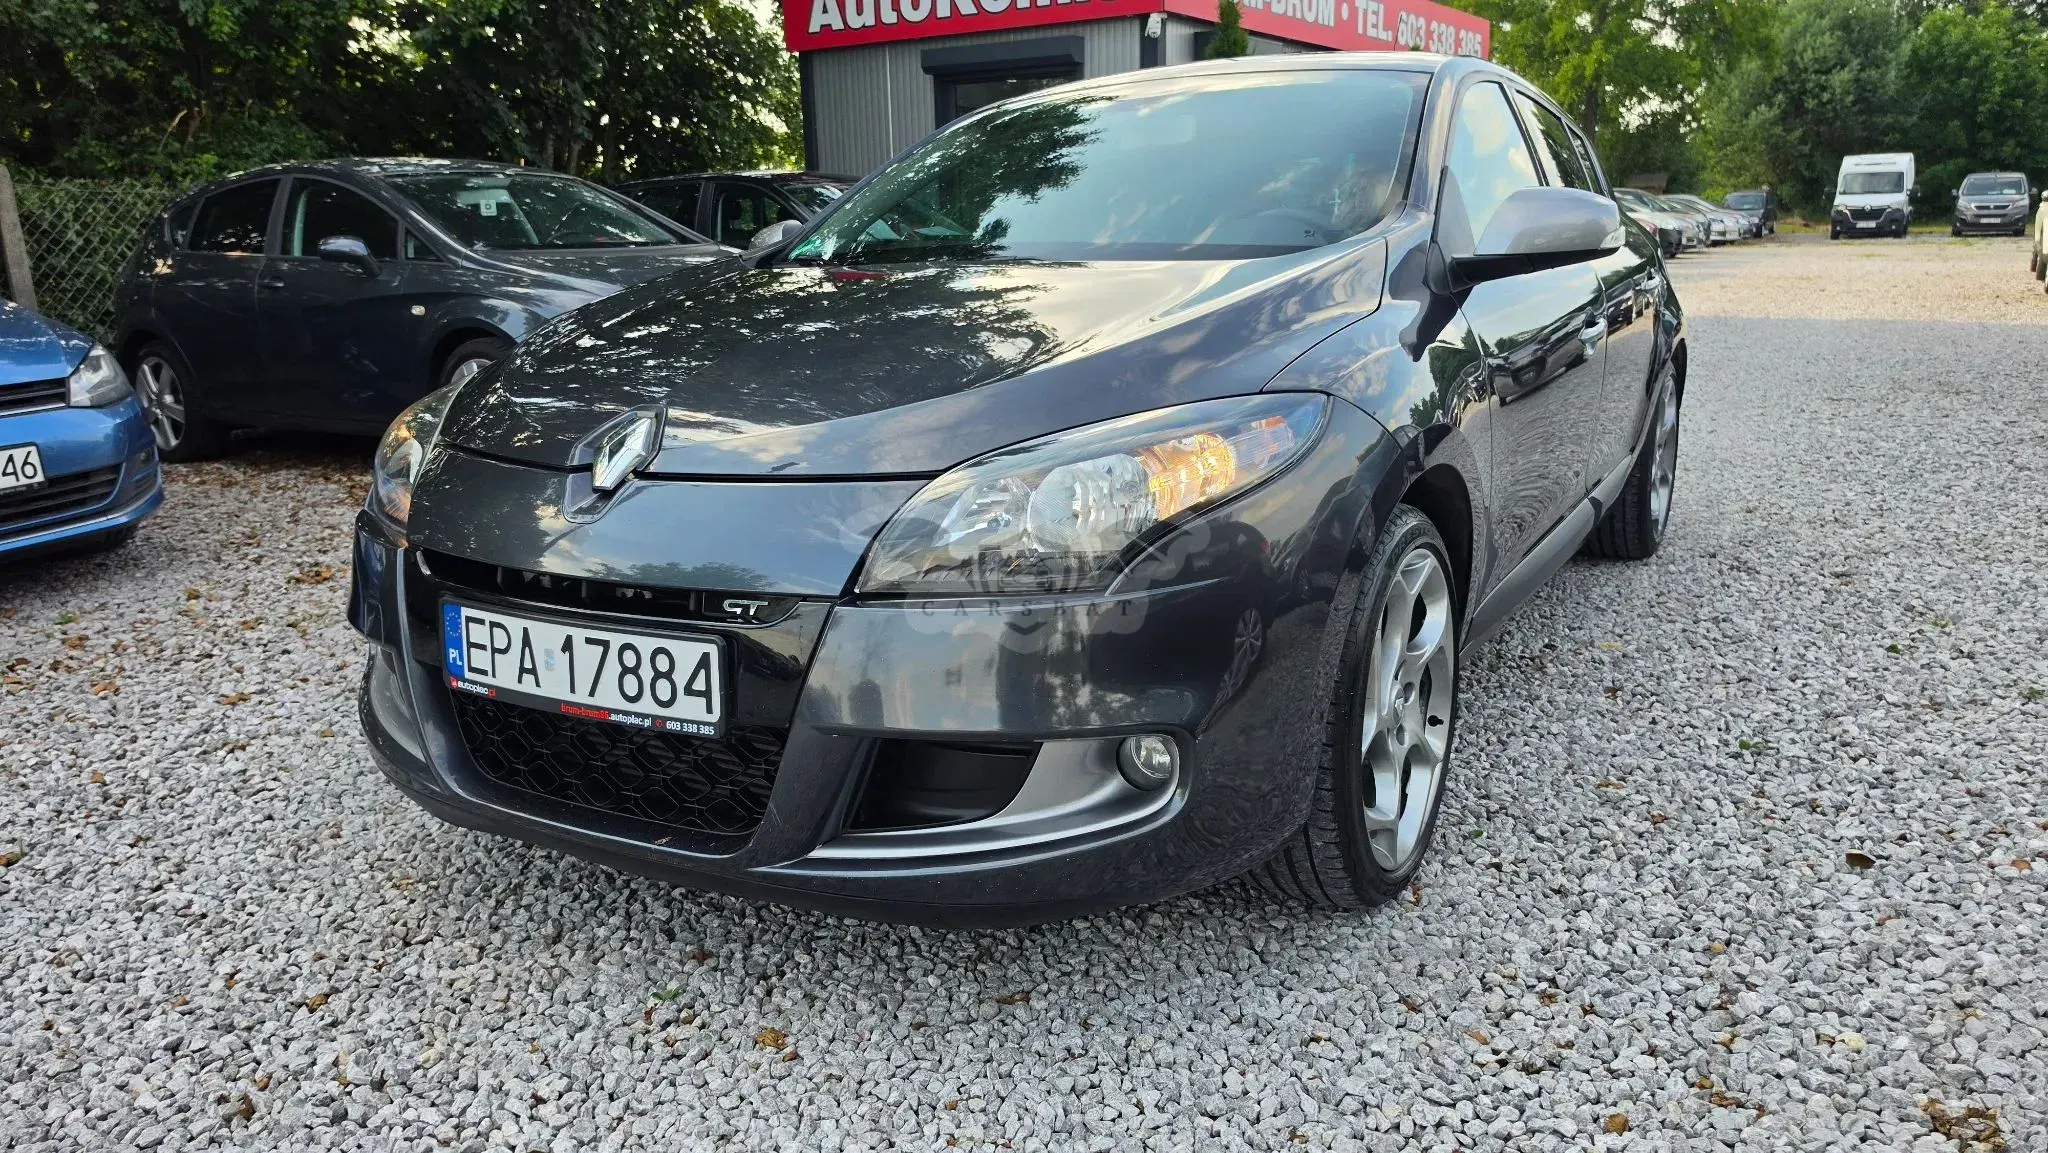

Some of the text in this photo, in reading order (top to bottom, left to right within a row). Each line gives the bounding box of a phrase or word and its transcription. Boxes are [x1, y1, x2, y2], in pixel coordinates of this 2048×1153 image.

[1354, 0, 1393, 42] TEL.
[1397, 11, 1426, 50] 603
[1429, 19, 1456, 54] 338
[1458, 28, 1483, 57] 385
[2, 450, 38, 482] 46
[449, 648, 463, 666] PL
[465, 615, 715, 716] EPA 17884
[666, 720, 681, 731] 603
[682, 723, 698, 733] 338
[699, 725, 715, 735] 385
